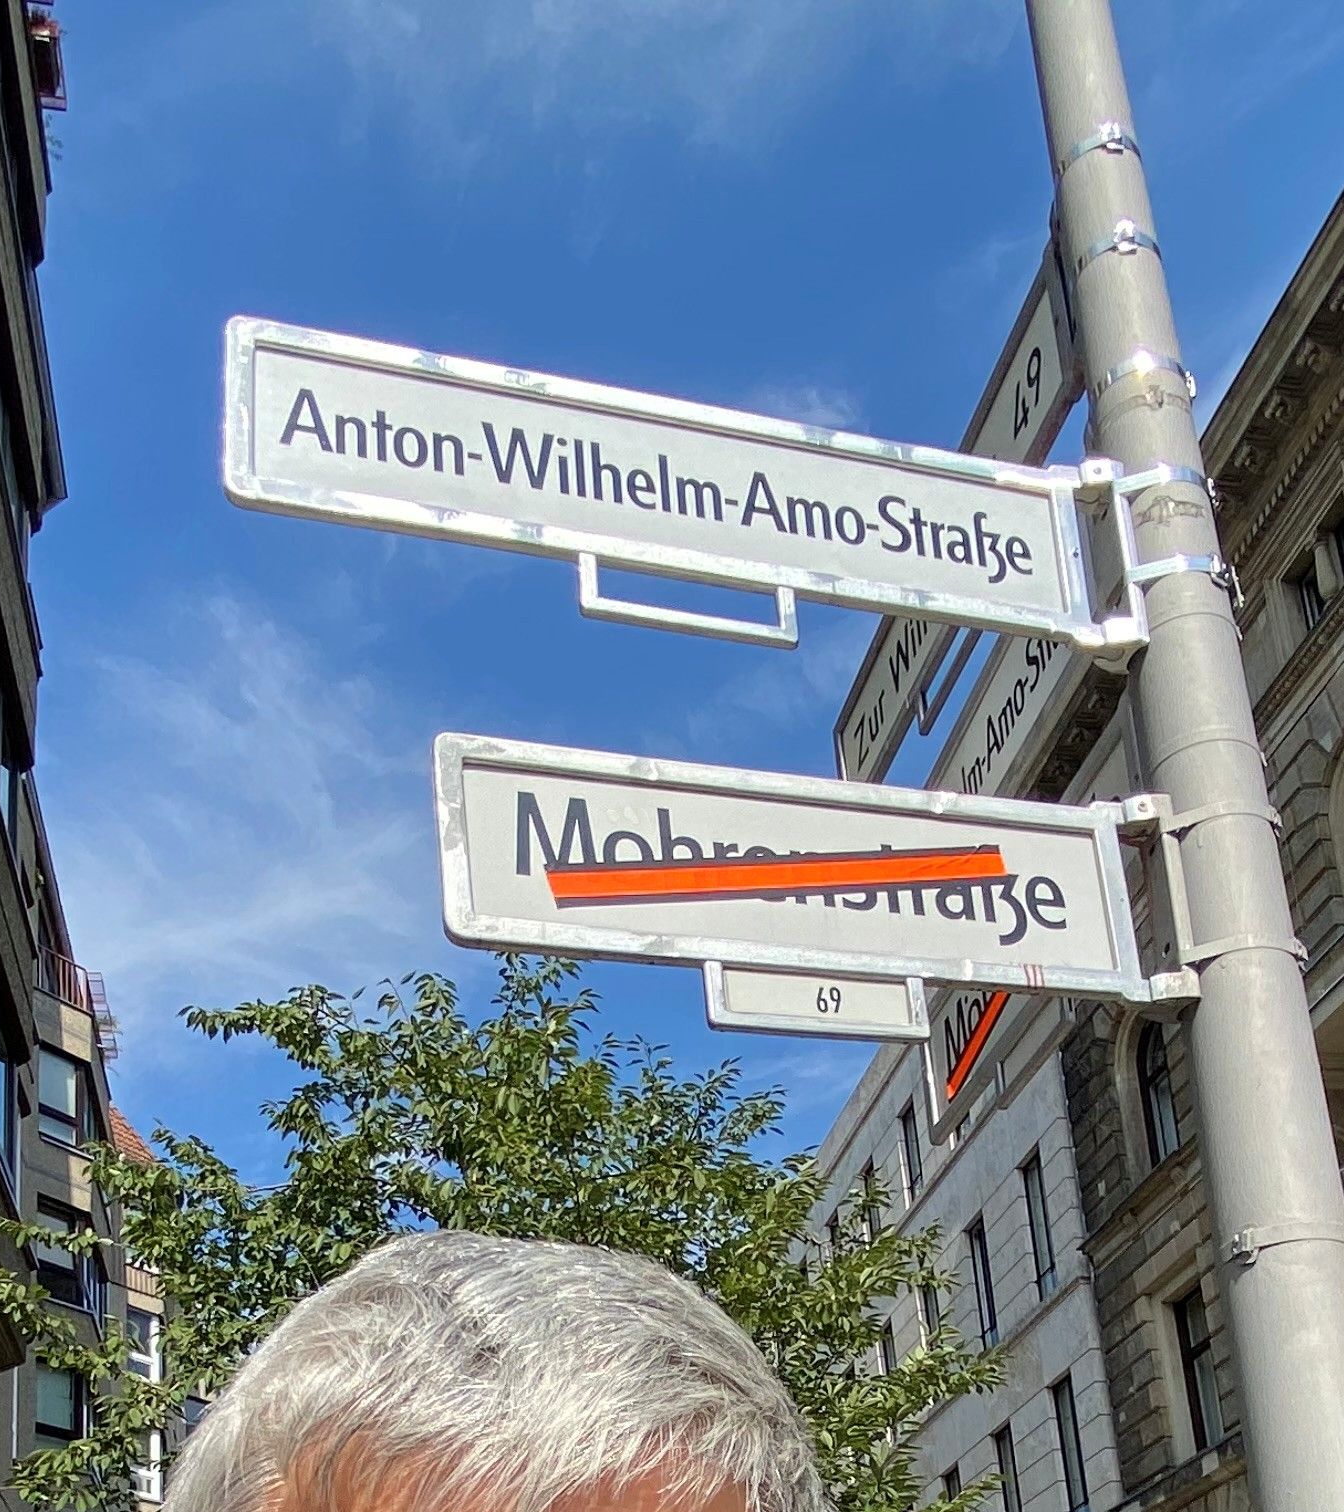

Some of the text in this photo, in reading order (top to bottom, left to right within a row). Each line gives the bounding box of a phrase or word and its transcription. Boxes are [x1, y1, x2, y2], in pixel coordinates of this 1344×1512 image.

[280, 388, 1034, 584] Anton-Wilhelm-Amo-Straße
[853, 690, 887, 773] Zur
[1014, 346, 1043, 441] 49
[815, 986, 842, 1015] 69
